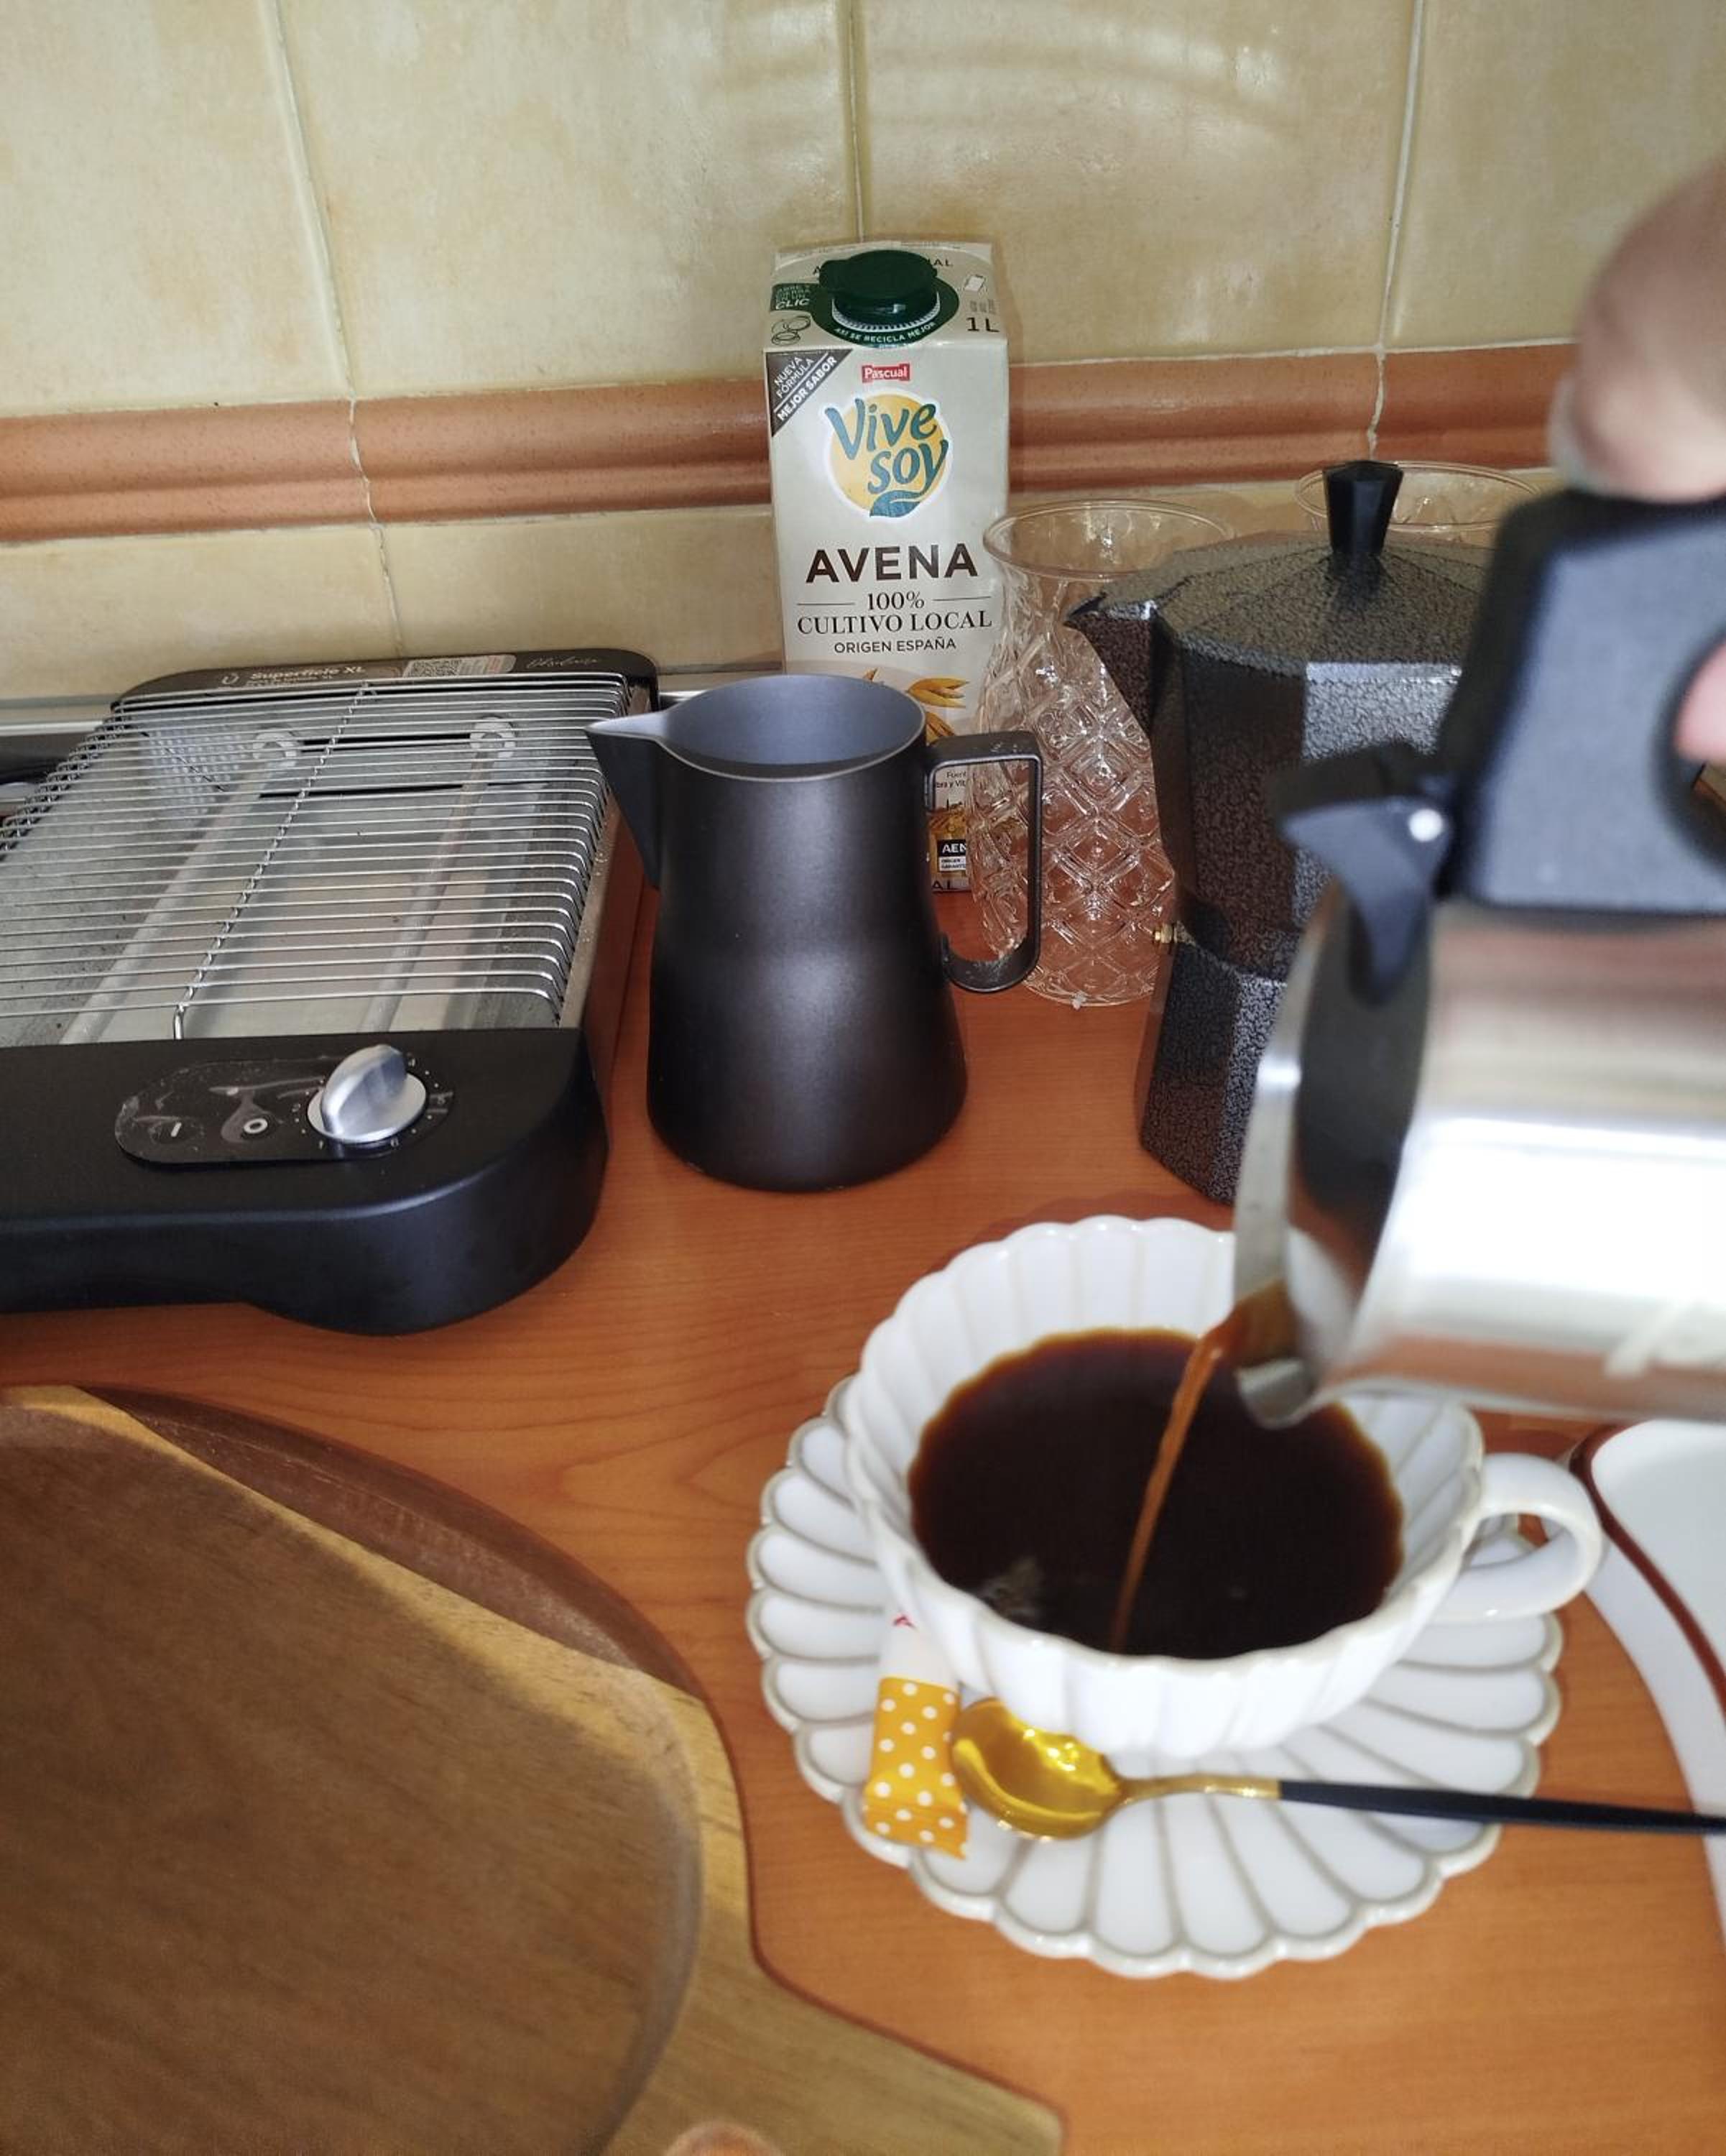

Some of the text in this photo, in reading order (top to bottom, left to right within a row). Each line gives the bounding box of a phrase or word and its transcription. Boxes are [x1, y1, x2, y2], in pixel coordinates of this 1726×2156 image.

[775, 298, 810, 310] CLIC
[863, 334, 905, 343] RECICLA
[907, 322, 936, 338] MEJOR
[774, 356, 803, 387] NUEVA
[864, 365, 908, 380] Pascual
[777, 356, 837, 421] MEJOR SABOR
[825, 398, 937, 460] Vive
[806, 543, 979, 584] AVENA
[867, 591, 925, 610] 100%
[798, 609, 993, 635] CULTIVO LOCAL
[834, 636, 956, 653] ORIGEN ESPAÑA
[343, 665, 365, 674] XL
